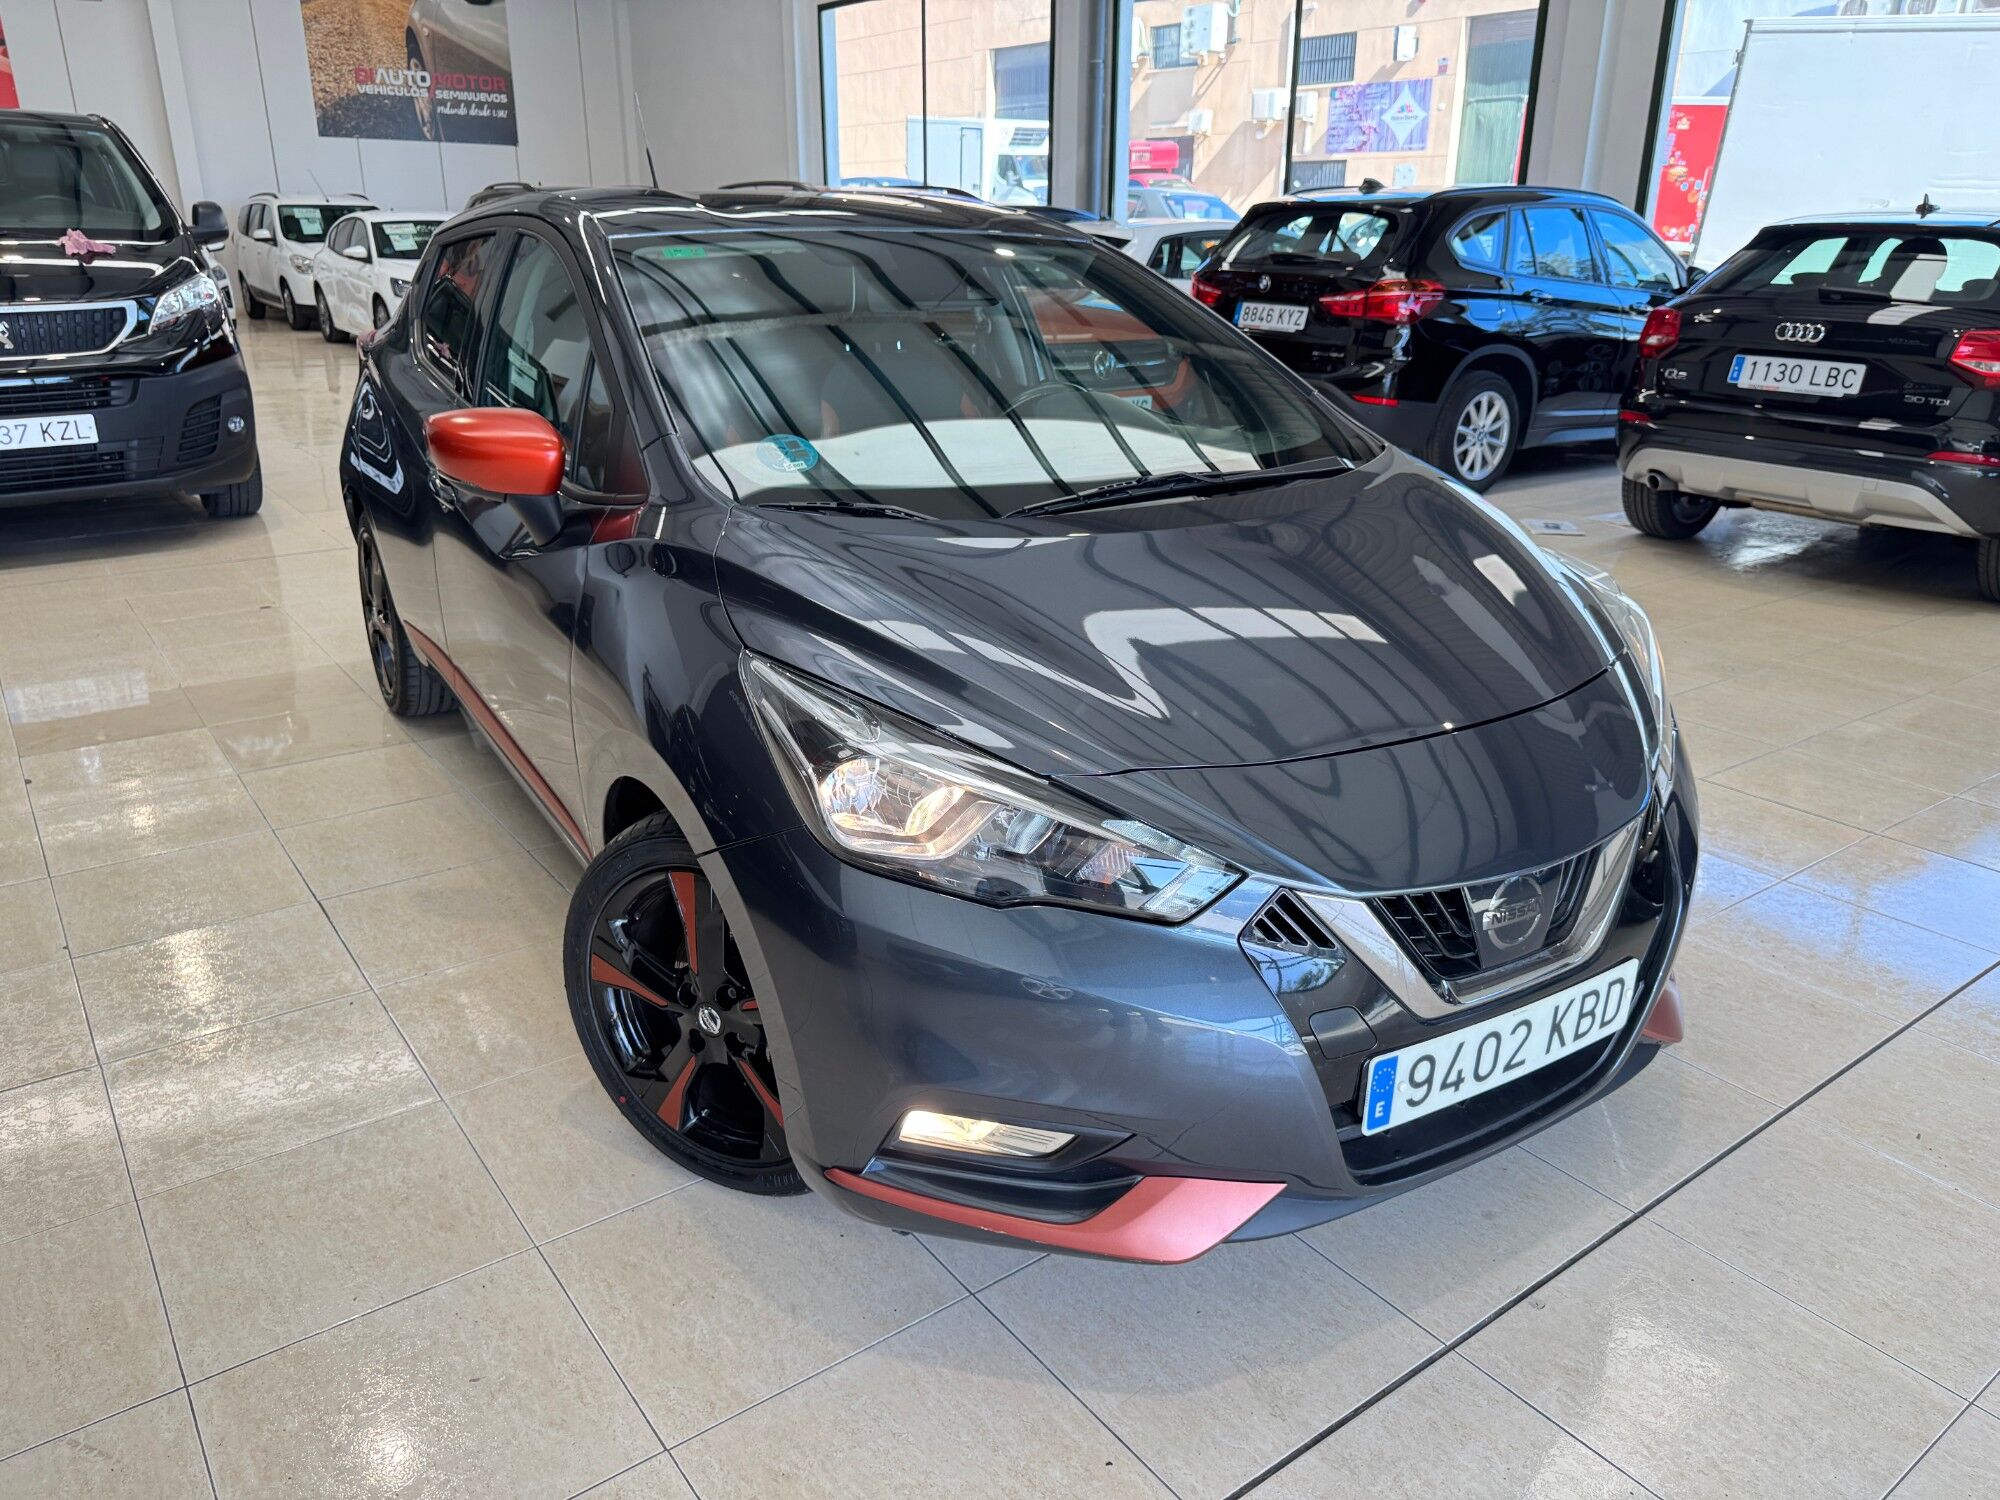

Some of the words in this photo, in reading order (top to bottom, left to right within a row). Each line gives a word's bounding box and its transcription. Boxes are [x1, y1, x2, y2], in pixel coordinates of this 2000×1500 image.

[435, 89, 508, 103] SEMINUEVOS
[1242, 306, 1275, 324] 8846
[1276, 308, 1305, 326] KYZ
[1749, 361, 1803, 384] 1130
[1809, 365, 1857, 389] LBC
[1903, 394, 1926, 404] 30
[1927, 397, 1951, 406] TDI
[39, 420, 91, 443] KZL
[1374, 1100, 1385, 1119] E
[1406, 1018, 1533, 1108] 9402
[1545, 977, 1625, 1055] KBD
